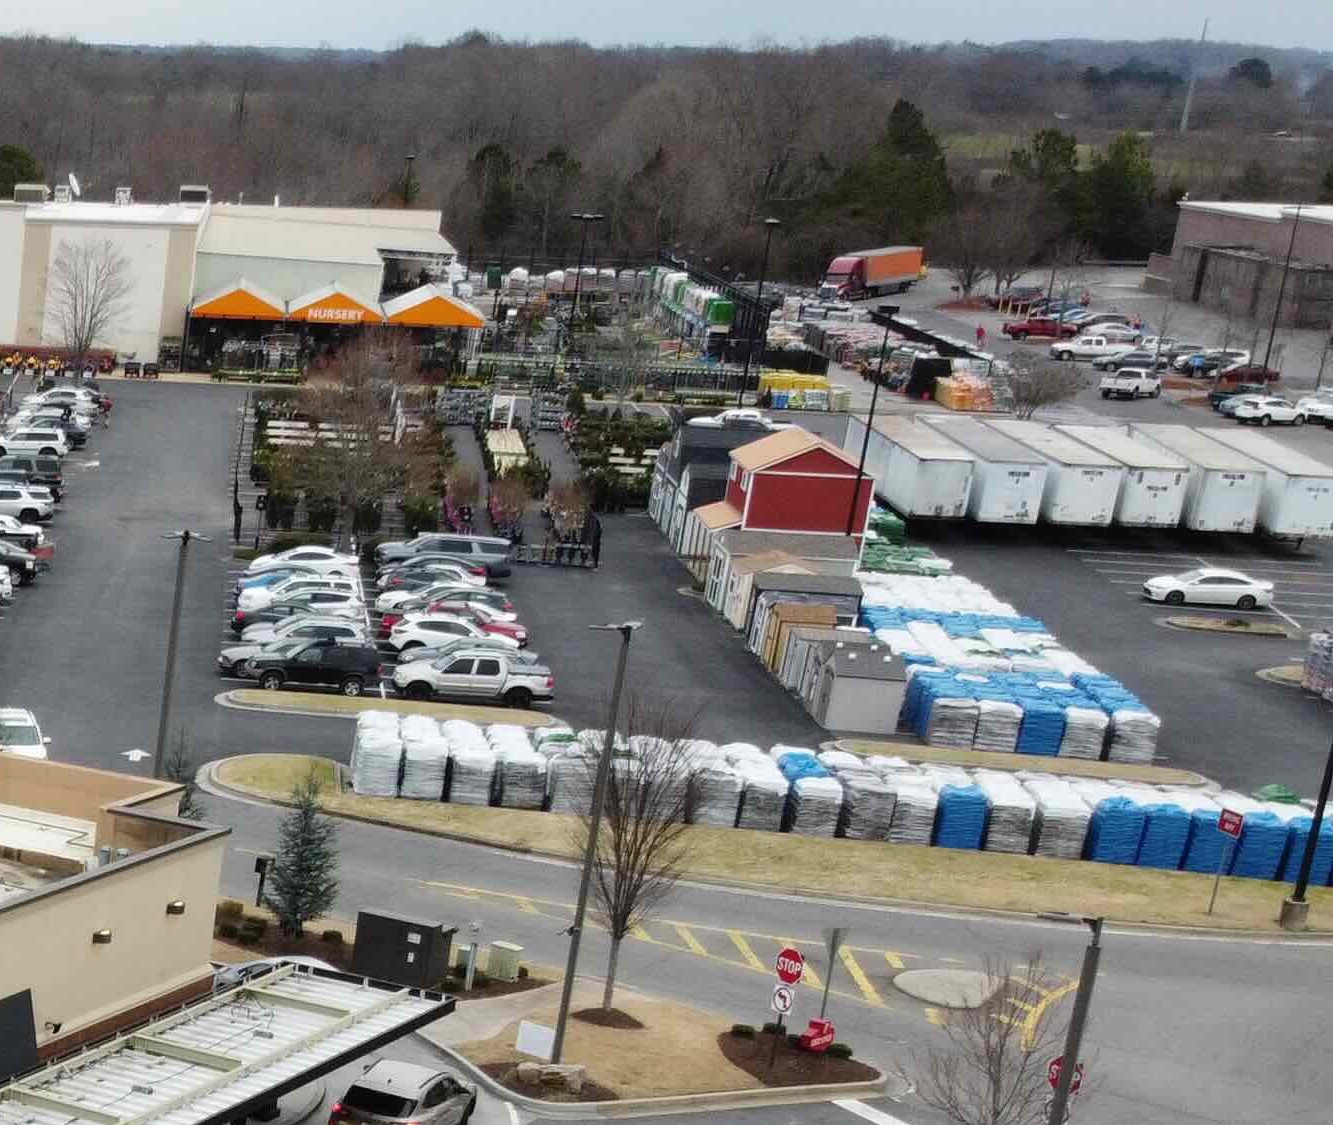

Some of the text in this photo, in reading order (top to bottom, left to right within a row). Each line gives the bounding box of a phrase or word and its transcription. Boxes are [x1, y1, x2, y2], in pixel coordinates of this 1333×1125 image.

[308, 307, 365, 321] NURSERY
[777, 956, 801, 975] STOP
[1049, 1065, 1080, 1080] SP
